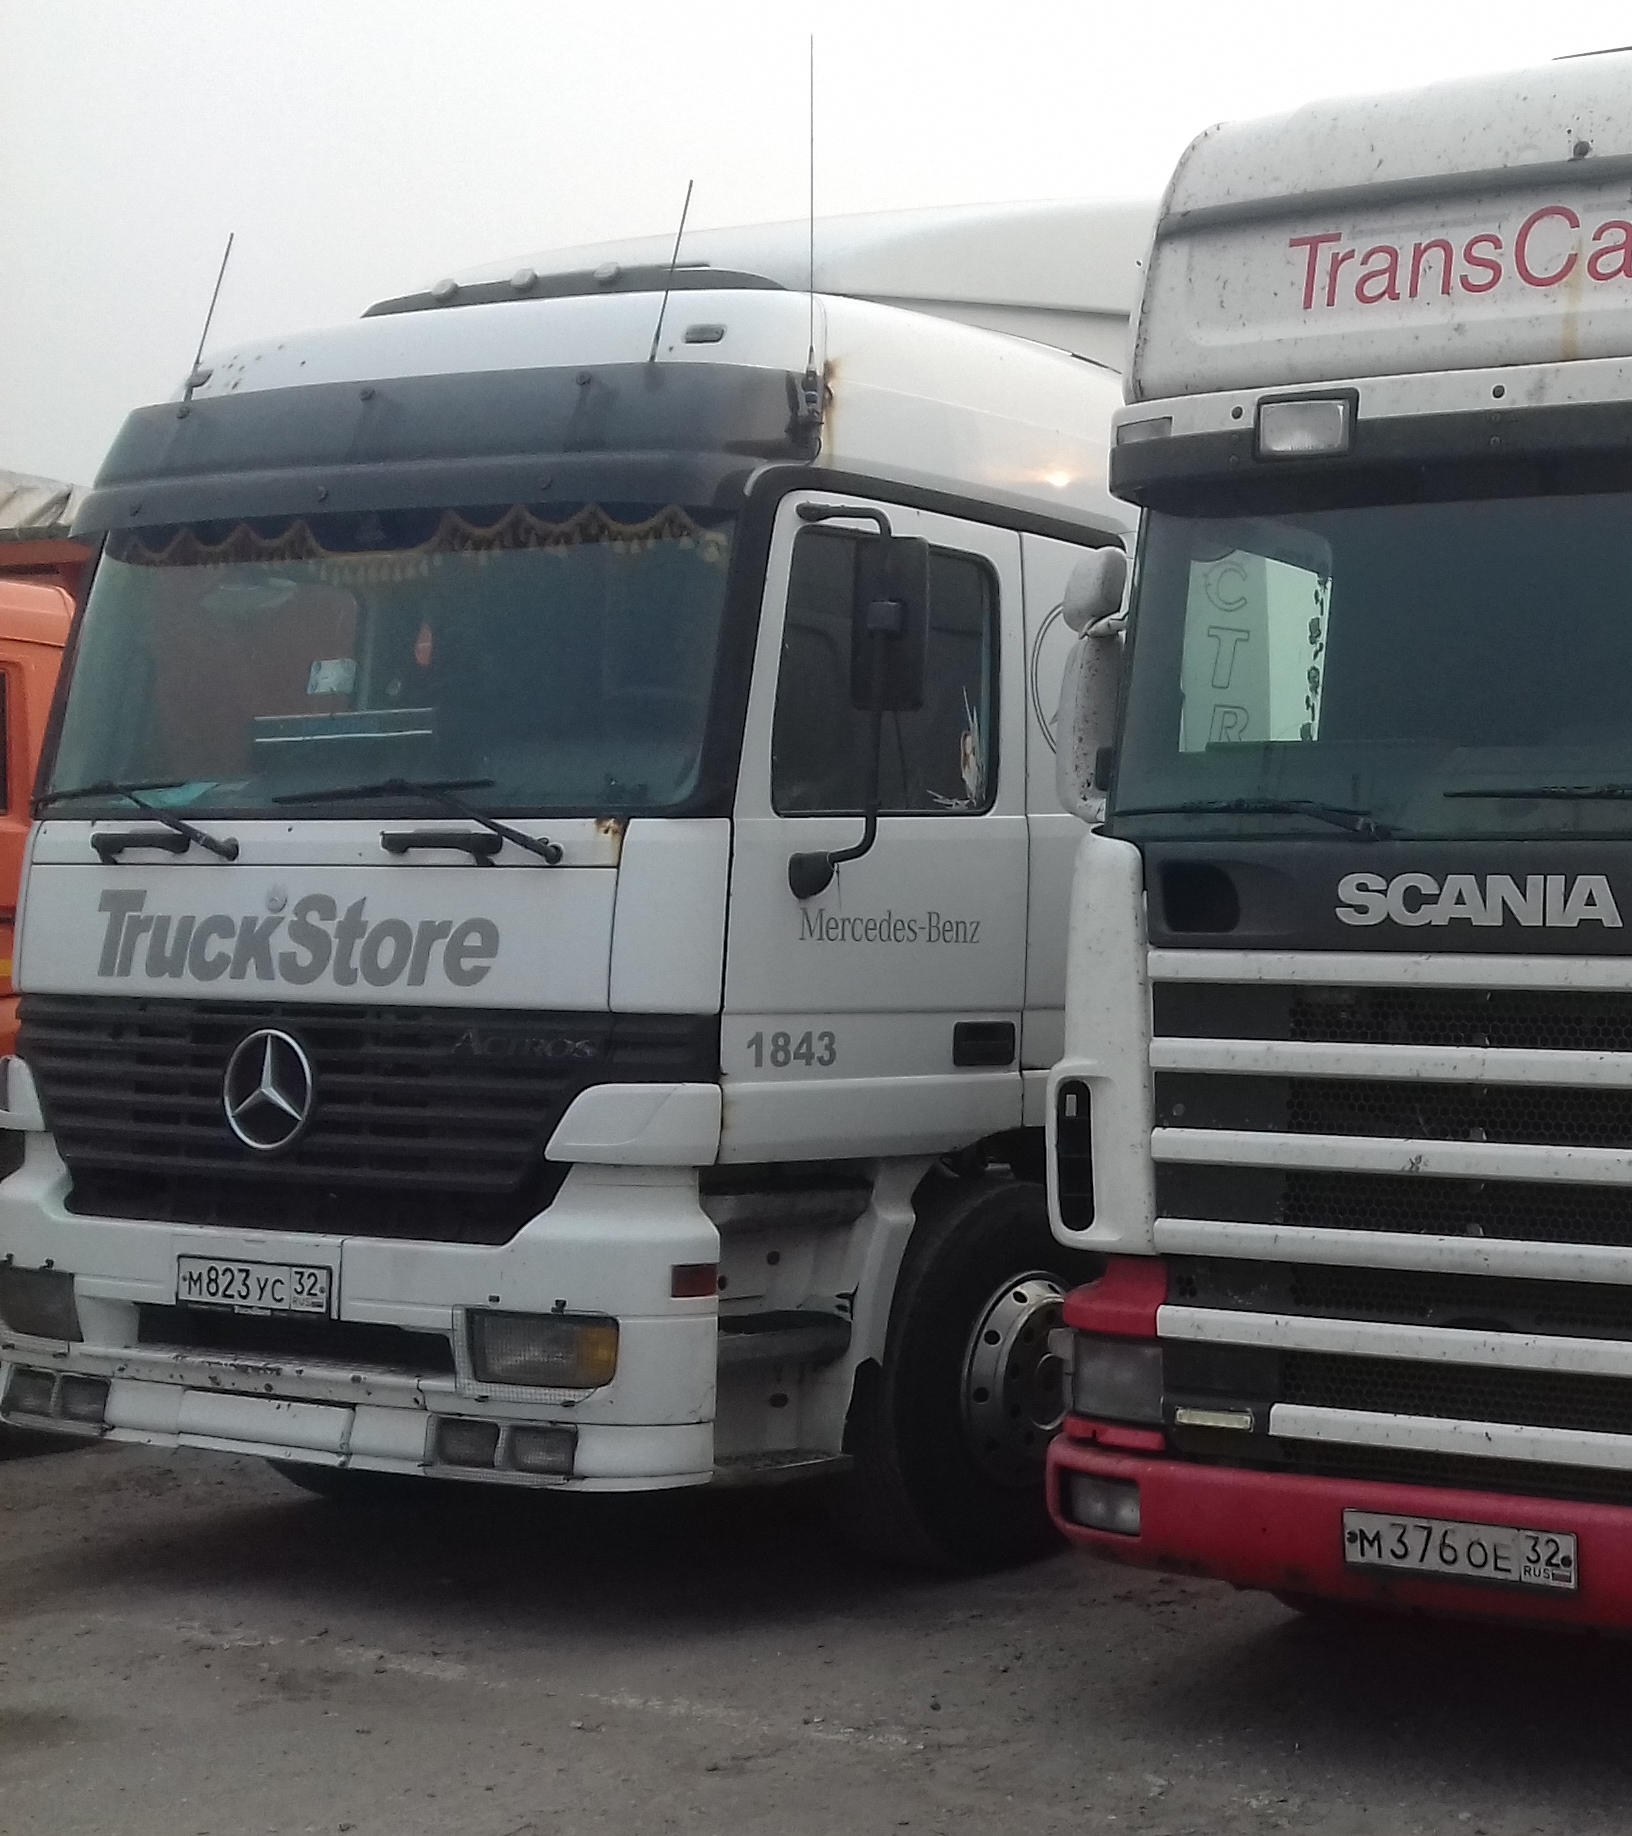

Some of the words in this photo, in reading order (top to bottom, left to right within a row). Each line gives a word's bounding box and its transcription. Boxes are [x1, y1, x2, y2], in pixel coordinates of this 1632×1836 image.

[1335, 872, 1624, 928] SCANIA
[97, 889, 500, 987] TruckStore
[798, 907, 981, 944] Mercedes-Benz
[746, 1031, 837, 1068] 1843
[293, 1270, 318, 1297] 32
[1524, 1534, 1561, 1568] 32
[1523, 1565, 1550, 1580] RUS
